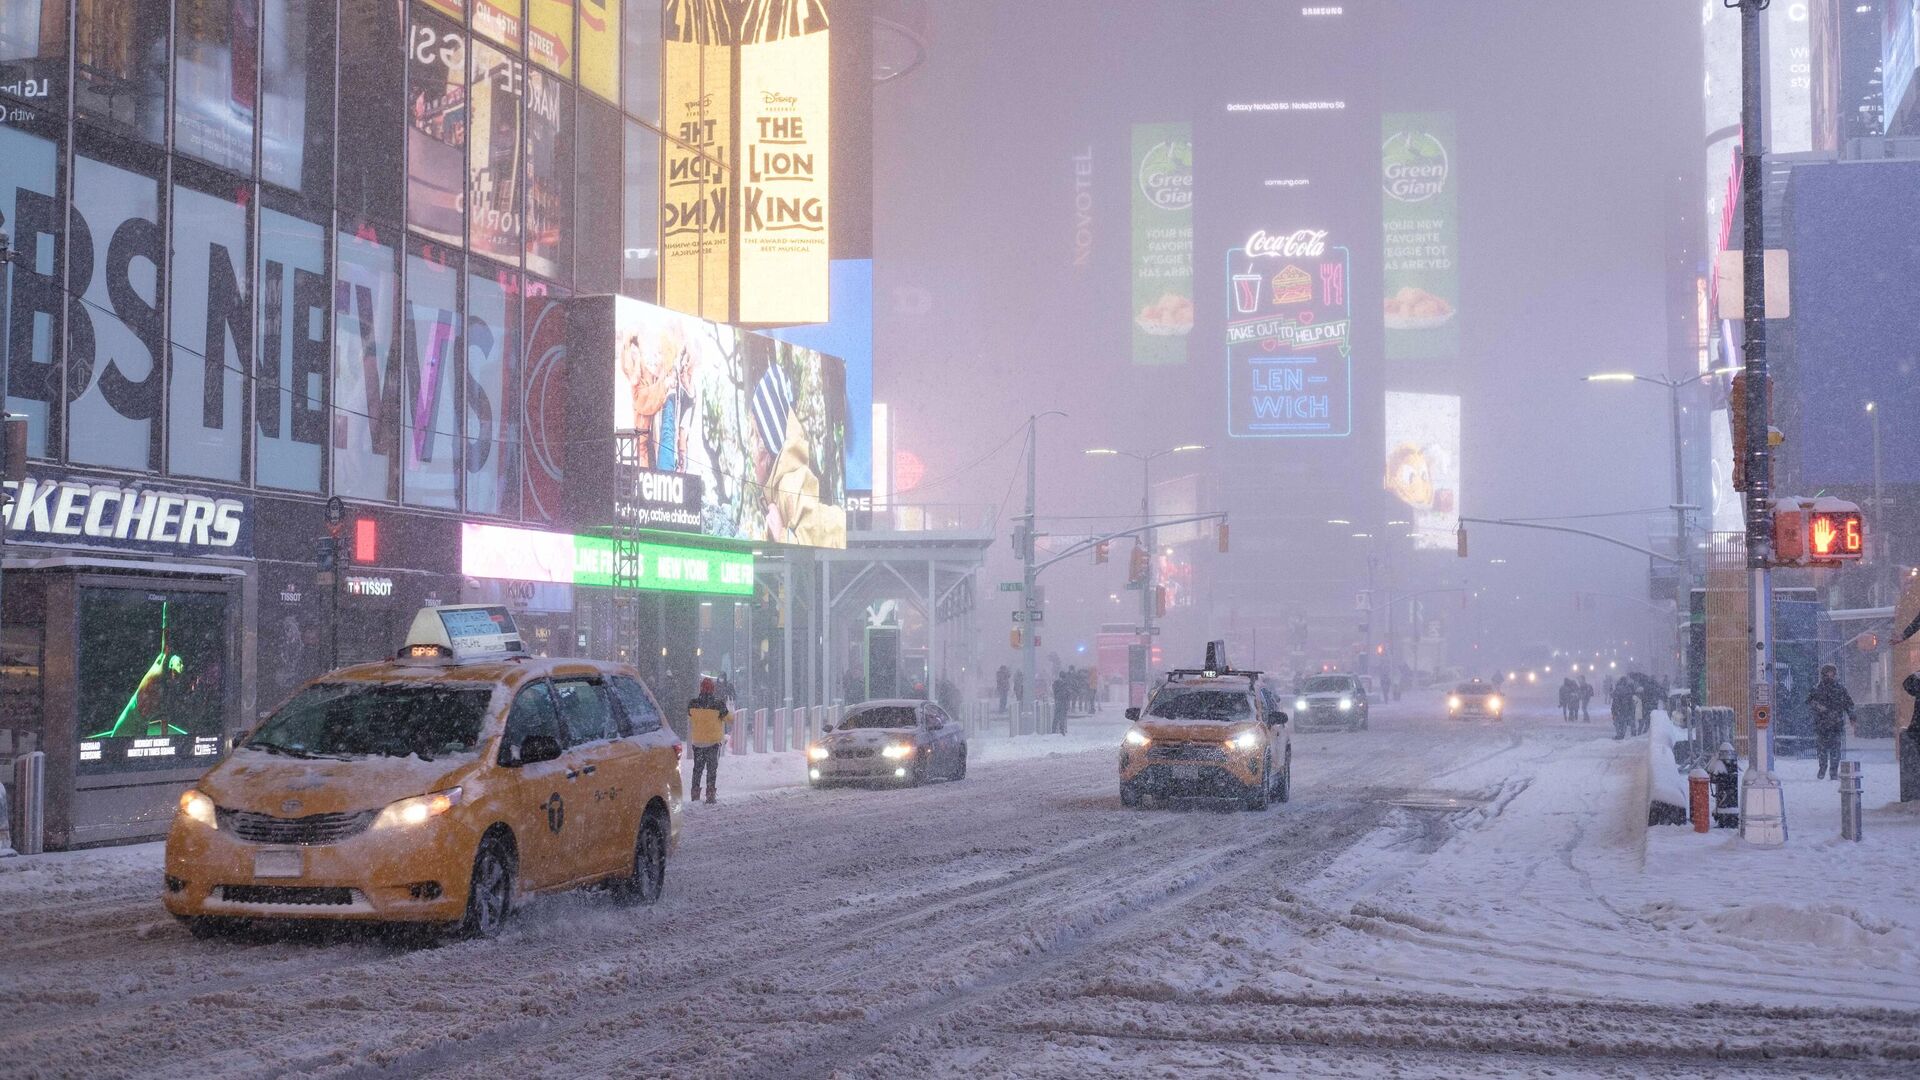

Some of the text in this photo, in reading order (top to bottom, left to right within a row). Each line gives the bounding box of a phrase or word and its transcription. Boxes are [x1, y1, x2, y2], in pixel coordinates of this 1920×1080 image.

[1302, 7, 1342, 15] SAMSUNG
[529, 30, 554, 57] STREET
[1226, 104, 1253, 112] Galaxy
[756, 117, 803, 139] THE
[748, 144, 813, 183] LION
[1385, 163, 1443, 179] Green
[1264, 178, 1309, 188] samsung.com
[1392, 178, 1443, 195] Giant
[743, 186, 823, 233] KING
[0, 187, 173, 421] BS
[1228, 321, 1347, 343] TAKE OUT TO HELP OUT
[1252, 395, 1329, 419] WICH
[1846, 519, 1860, 551] 6
[657, 556, 681, 580] NEW
[684, 558, 709, 582] YORK
[281, 592, 301, 601] TISSOT
[361, 582, 393, 596] TISSOT
